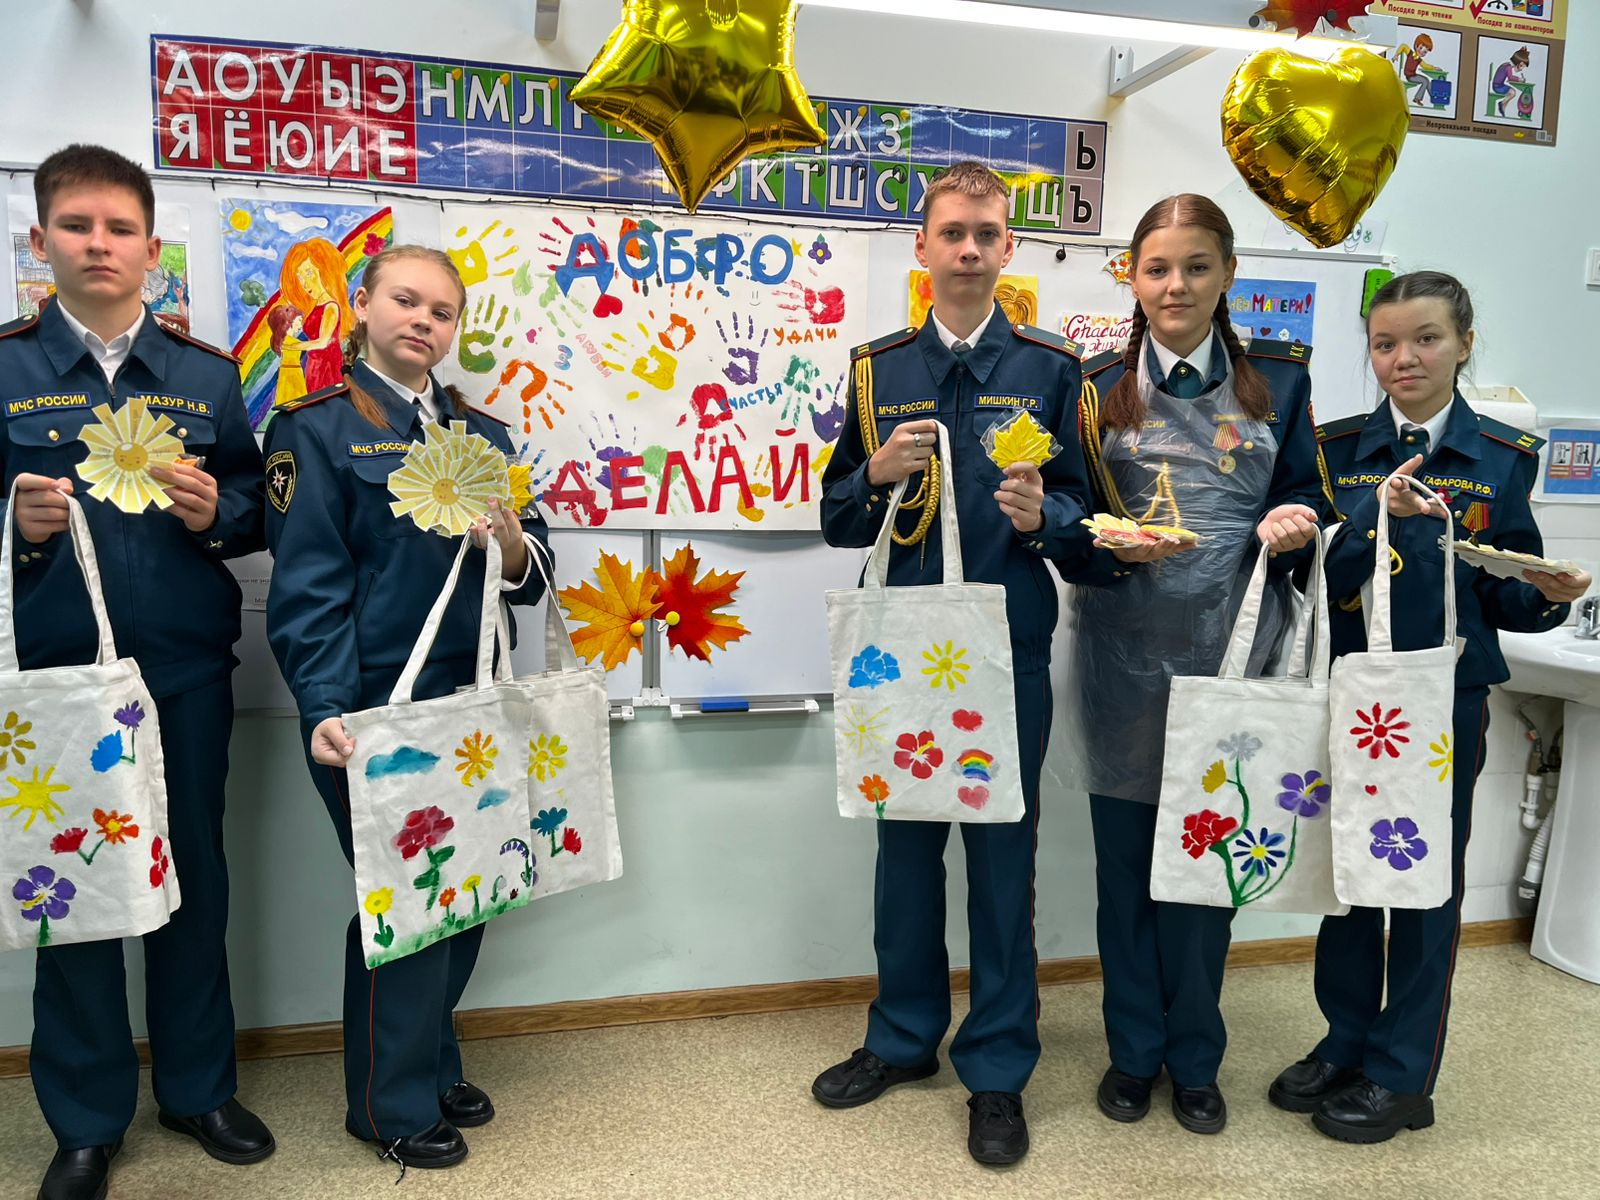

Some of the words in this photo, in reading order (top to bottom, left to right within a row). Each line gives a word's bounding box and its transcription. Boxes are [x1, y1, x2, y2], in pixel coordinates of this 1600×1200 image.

[554, 228, 795, 298] ДОБРО
[773, 327, 837, 346] УДАЧИ
[9, 400, 35, 414] МЧС
[36, 394, 87, 412] РОССИИ
[139, 394, 184, 408] МАЗУР
[187, 401, 211, 414] Н.В.
[719, 382, 783, 412] СЧАСТЬЯ
[978, 395, 1021, 407] МИШКИН
[1022, 398, 1038, 409] Г.Р.
[878, 404, 899, 416] МЧС
[900, 400, 936, 415] РОССИИ
[351, 444, 374, 454] МЧС
[542, 427, 811, 517] ДЕЛАЙ
[1338, 475, 1358, 485] МЧС
[1359, 475, 1387, 484] РОСС
[1423, 475, 1473, 491] ГАФАРОВА
[1475, 483, 1493, 496] Р.Ф.
